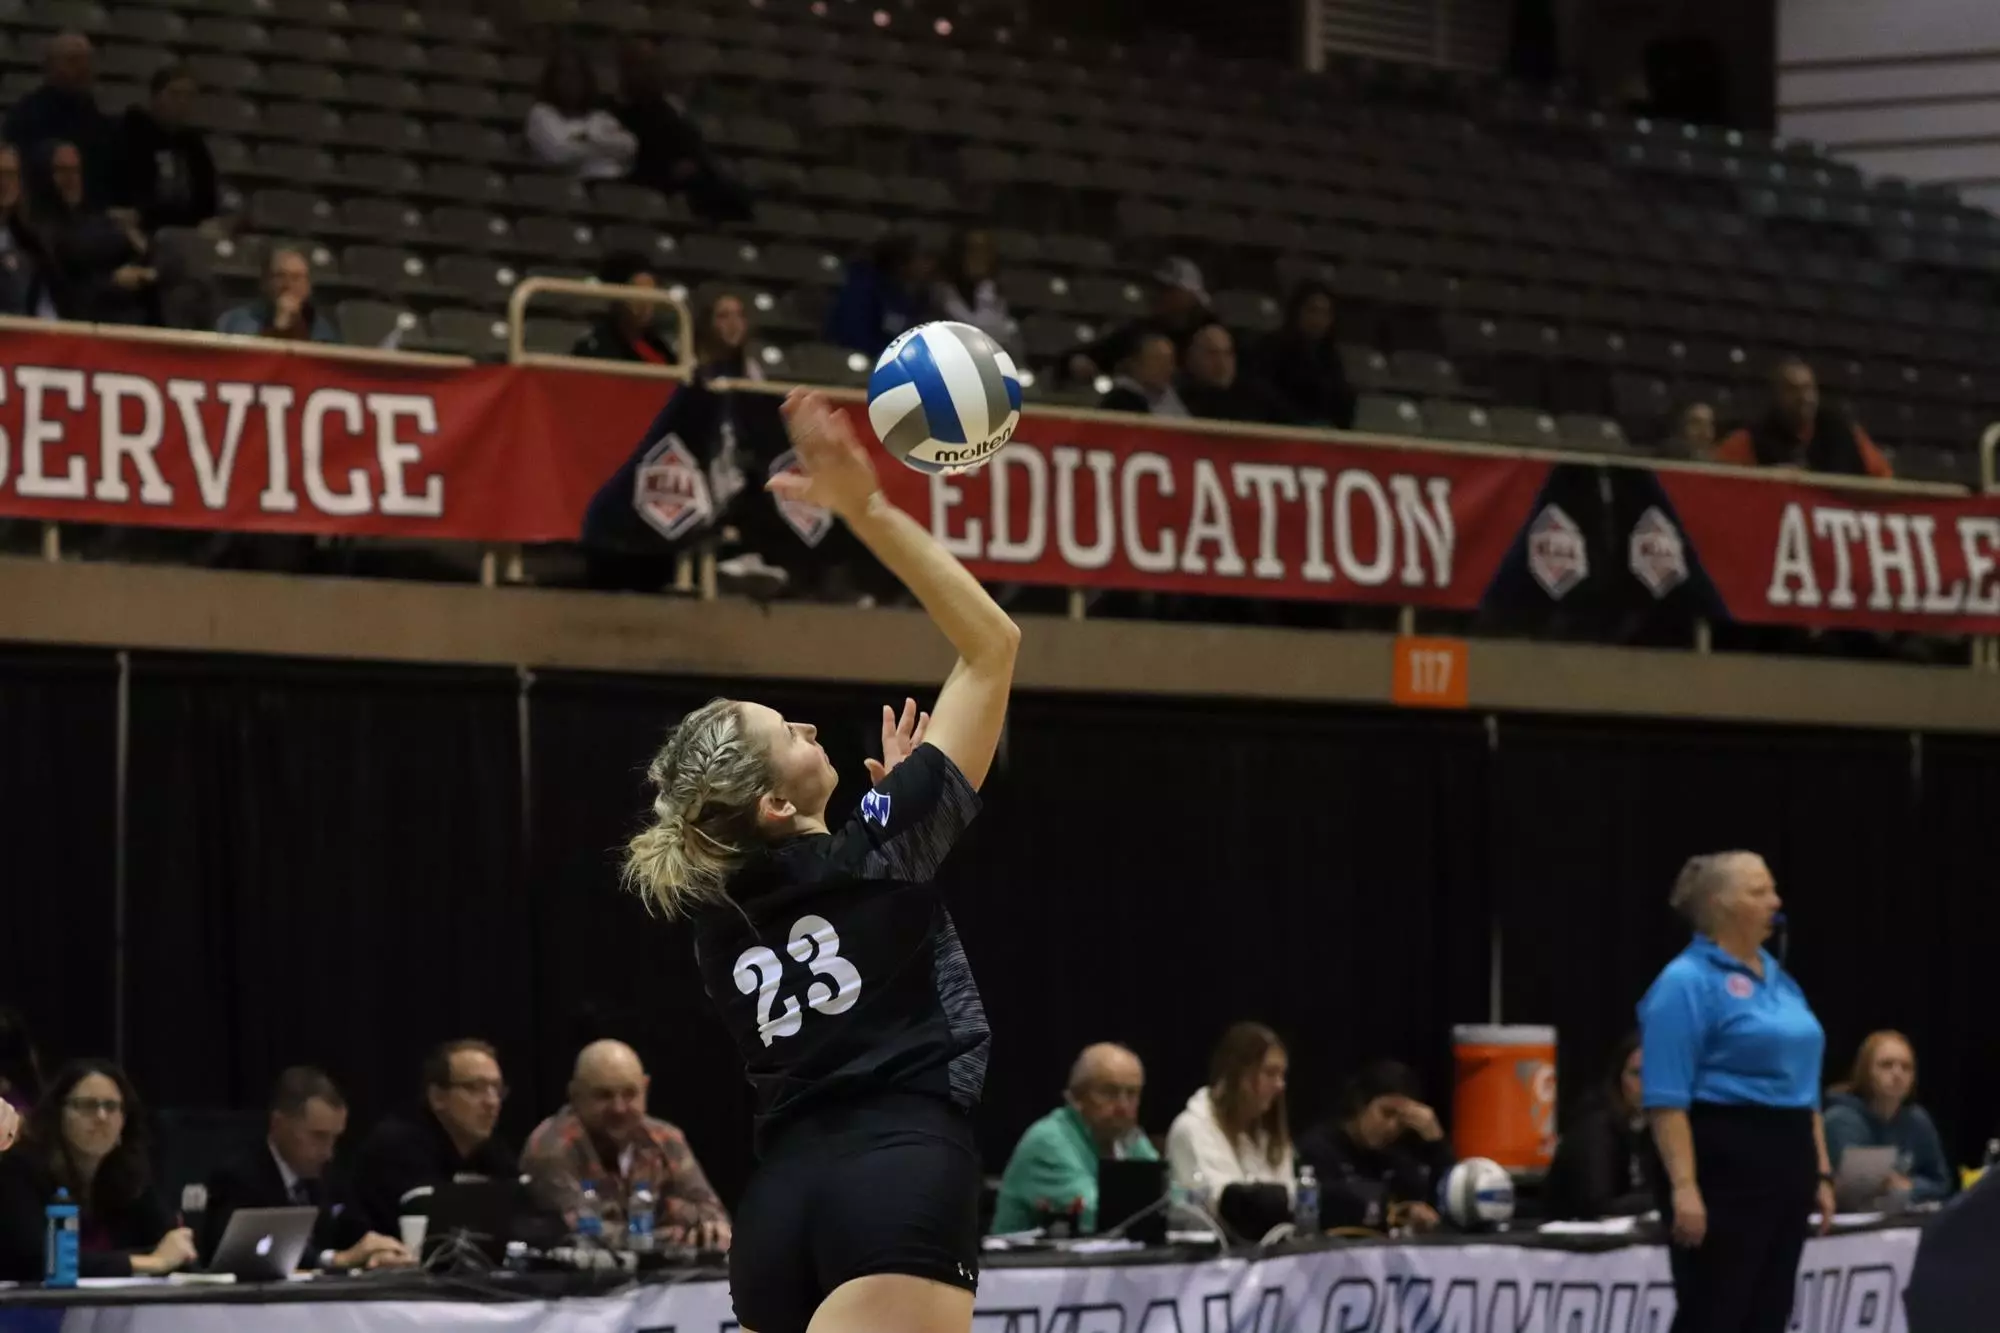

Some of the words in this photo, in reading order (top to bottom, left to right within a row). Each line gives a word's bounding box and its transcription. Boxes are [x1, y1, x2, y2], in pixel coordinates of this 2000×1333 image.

[0, 365, 444, 517] ERVICE
[934, 426, 1012, 462] molten
[929, 442, 1456, 588] EDUCATION
[1766, 502, 2000, 617] ATHLE
[1409, 648, 1454, 695] 117
[733, 914, 862, 1048] 23
